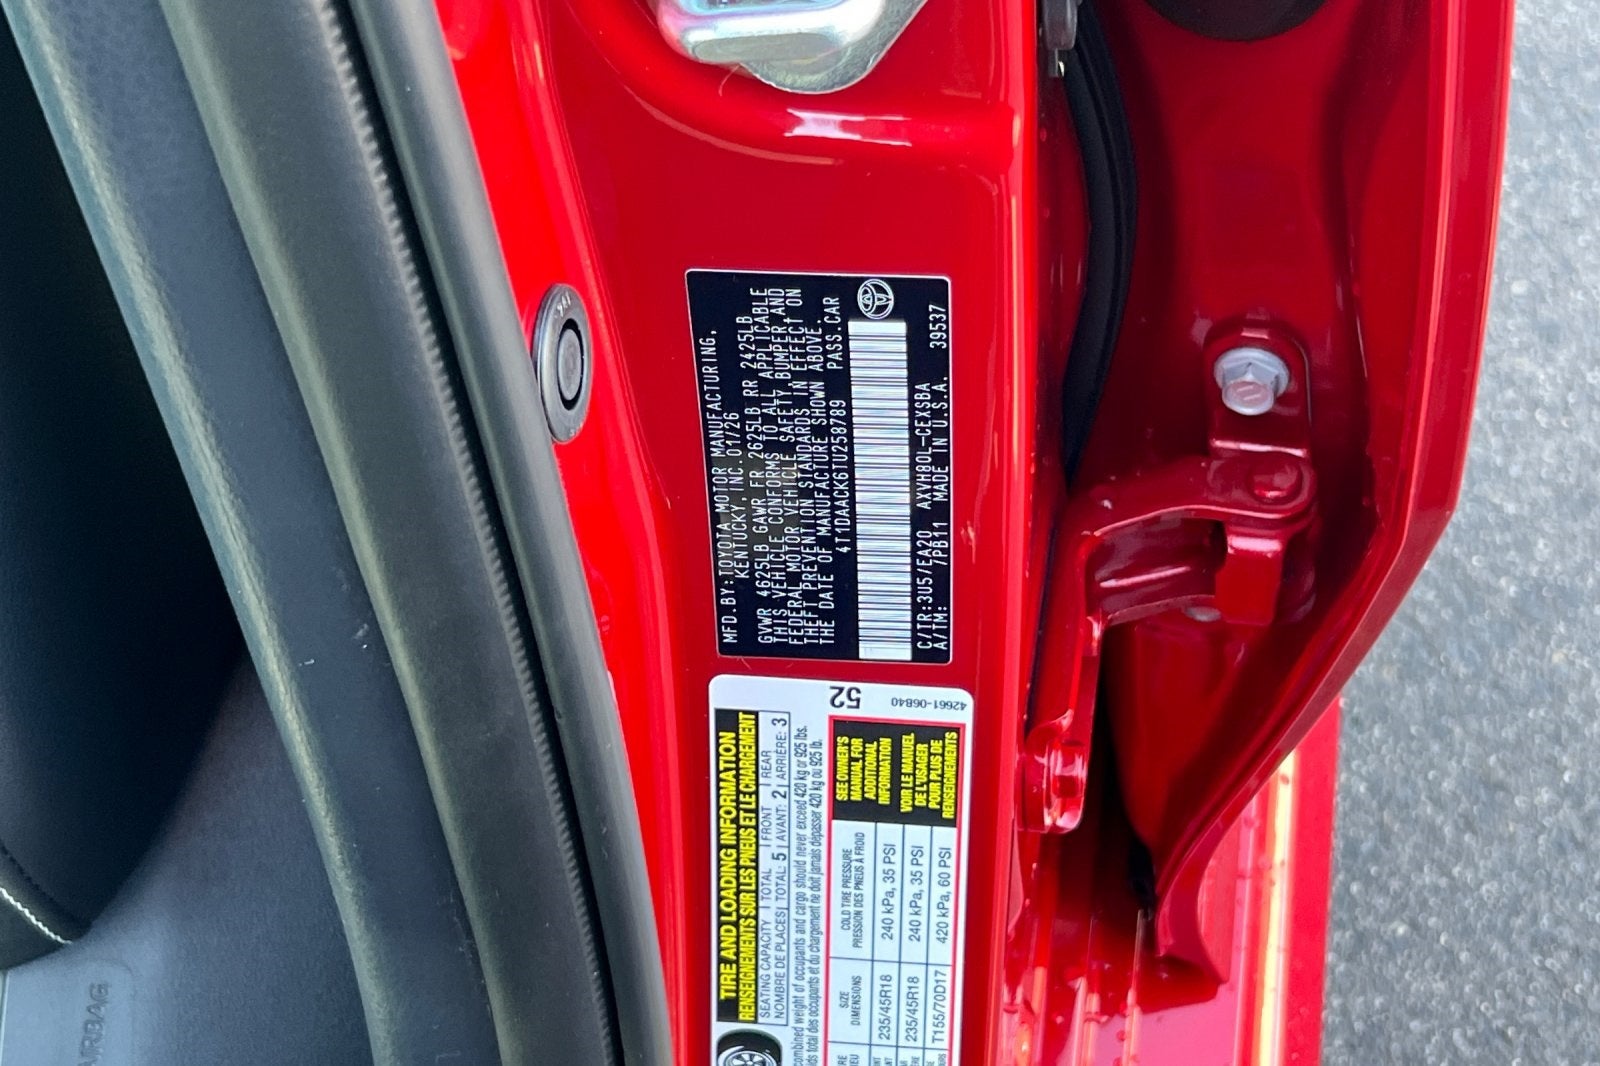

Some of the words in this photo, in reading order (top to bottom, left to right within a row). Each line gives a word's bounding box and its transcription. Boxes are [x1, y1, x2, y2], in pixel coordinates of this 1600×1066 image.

[785, 289, 803, 306] ON
[750, 287, 774, 379] APPLICABLE
[822, 297, 843, 369] PASS.CAR
[929, 304, 946, 349] 39537
[736, 316, 757, 369] 2425LB
[785, 317, 808, 371] EFFECT
[805, 319, 823, 371] ABOVE.
[699, 330, 726, 457] MANUFACTURING,
[742, 380, 759, 397] RR
[792, 381, 809, 395] IN
[932, 376, 948, 427] U.S.A.
[760, 389, 777, 415] ALL
[810, 381, 827, 425] SHOWN
[744, 407, 764, 459] 2625LB
[763, 425, 778, 441] TO
[915, 382, 932, 509] AXVH80L-CEXSBA
[932, 438, 948, 453] IN
[798, 408, 813, 488] STANDARDS
[712, 467, 727, 512] MOTOR
[749, 471, 765, 488] FR
[766, 452, 783, 524] CONFORMS
[782, 454, 799, 515] VEHICLE
[814, 436, 832, 536] MANUFACTURE
[829, 399, 851, 553] 4T1DAACK6TU258789
[932, 466, 948, 501] MADE
[751, 498, 768, 533] GAWR
[784, 526, 801, 572] MOTOR
[799, 499, 818, 590] PREVENTION
[817, 546, 833, 563] OF
[932, 522, 948, 565] /PB11
[753, 544, 771, 597] 4625LB
[769, 535, 787, 598] VEHICLE
[818, 574, 834, 609] DATE
[756, 608, 772, 644] GVWR
[772, 608, 788, 643] THIS
[787, 582, 804, 644] FEDERAL
[802, 600, 819, 644] THEFT
[819, 620, 834, 644] THE
[933, 606, 948, 649] A/TM:
[829, 685, 861, 709] 52
[891, 697, 967, 711] 42661-06B40
[772, 718, 787, 727] 3
[794, 726, 806, 740] lbs.
[738, 712, 755, 792] CHARGEMENT
[794, 743, 806, 758] 925
[810, 740, 822, 749] lb.
[851, 738, 863, 758] FOR
[901, 733, 914, 773] MANUEL
[930, 739, 942, 753] DE
[761, 750, 771, 778] REAR
[796, 759, 806, 768] or
[810, 751, 822, 766] 925
[836, 736, 849, 781] OWNER'S
[865, 741, 877, 799] ADDITIONAL
[878, 737, 892, 804] INFORMATION
[915, 743, 928, 790] L'USAGER
[929, 755, 942, 781] PLUS
[794, 771, 810, 780] kg
[810, 781, 824, 791] kg
[812, 769, 822, 778] ou
[850, 760, 862, 801] MANUAL
[901, 775, 913, 787] LE
[942, 731, 957, 818] RENSEIGNEMENTS
[718, 731, 737, 845] INFORMATION
[739, 794, 756, 808] LE
[772, 790, 787, 799] 2
[794, 783, 806, 798] 420
[809, 793, 822, 808] 420
[836, 782, 848, 801] SEE
[900, 789, 913, 812] VOIR
[915, 792, 927, 806] DE
[929, 783, 941, 809] POUR
[739, 810, 756, 826] ET
[761, 805, 771, 841] FRONT
[776, 804, 786, 842] AVANT:
[794, 800, 806, 829] exceed
[739, 828, 756, 865] PNEUS
[772, 853, 787, 861] 5
[796, 832, 806, 856] never
[854, 832, 865, 855] FROID
[883, 844, 895, 864] PSI
[911, 845, 923, 866] PSI
[809, 849, 823, 875] jamais
[842, 849, 852, 888] PRESSURE
[939, 847, 951, 868] PSI
[719, 849, 737, 920] LOADING
[739, 868, 757, 890] LES
[761, 868, 771, 901] TOTAL
[775, 866, 786, 901] TOTAL:
[793, 860, 806, 888] should
[809, 876, 821, 891] doit
[854, 866, 864, 890] PNEUS
[883, 868, 894, 884] 35
[910, 870, 922, 885] 35
[938, 872, 950, 887] 60
[739, 892, 756, 916] SUR
[795, 892, 808, 915] cargo
[810, 894, 820, 903] ne
[842, 891, 851, 908] TIRE
[854, 893, 863, 908] DES
[882, 888, 896, 914] kPa,
[909, 889, 923, 916] kPa,
[937, 891, 951, 918] kPa,
[774, 911, 786, 952] PLACES
[793, 919, 806, 934] and
[808, 906, 823, 952] chargement
[841, 910, 851, 930] COLD
[854, 910, 863, 948] PRESSION
[881, 918, 894, 940] 240
[908, 919, 921, 942] 240
[936, 922, 948, 944] 420
[719, 925, 737, 959] AND
[760, 919, 771, 971] CAPACITY
[738, 918, 756, 1020] RENSEIGNEMENTS
[774, 954, 785, 968] DE
[793, 938, 808, 981] occupants
[808, 955, 819, 964] du
[719, 963, 737, 999] TIRE
[792, 983, 805, 992] of
[760, 974, 771, 1018] SEATING
[774, 973, 785, 1019] NOMBRE
[806, 977, 821, 1017] occupants
[840, 991, 849, 1008] SIZE
[852, 975, 862, 1026] DIMENSIONS
[879, 974, 892, 1040] 235/45R18
[905, 976, 919, 1042] 235/45R18
[932, 970, 946, 1044] T155/70D17
[792, 996, 806, 1024] weight
[806, 1019, 818, 1033] des
[806, 1035, 818, 1052] total
